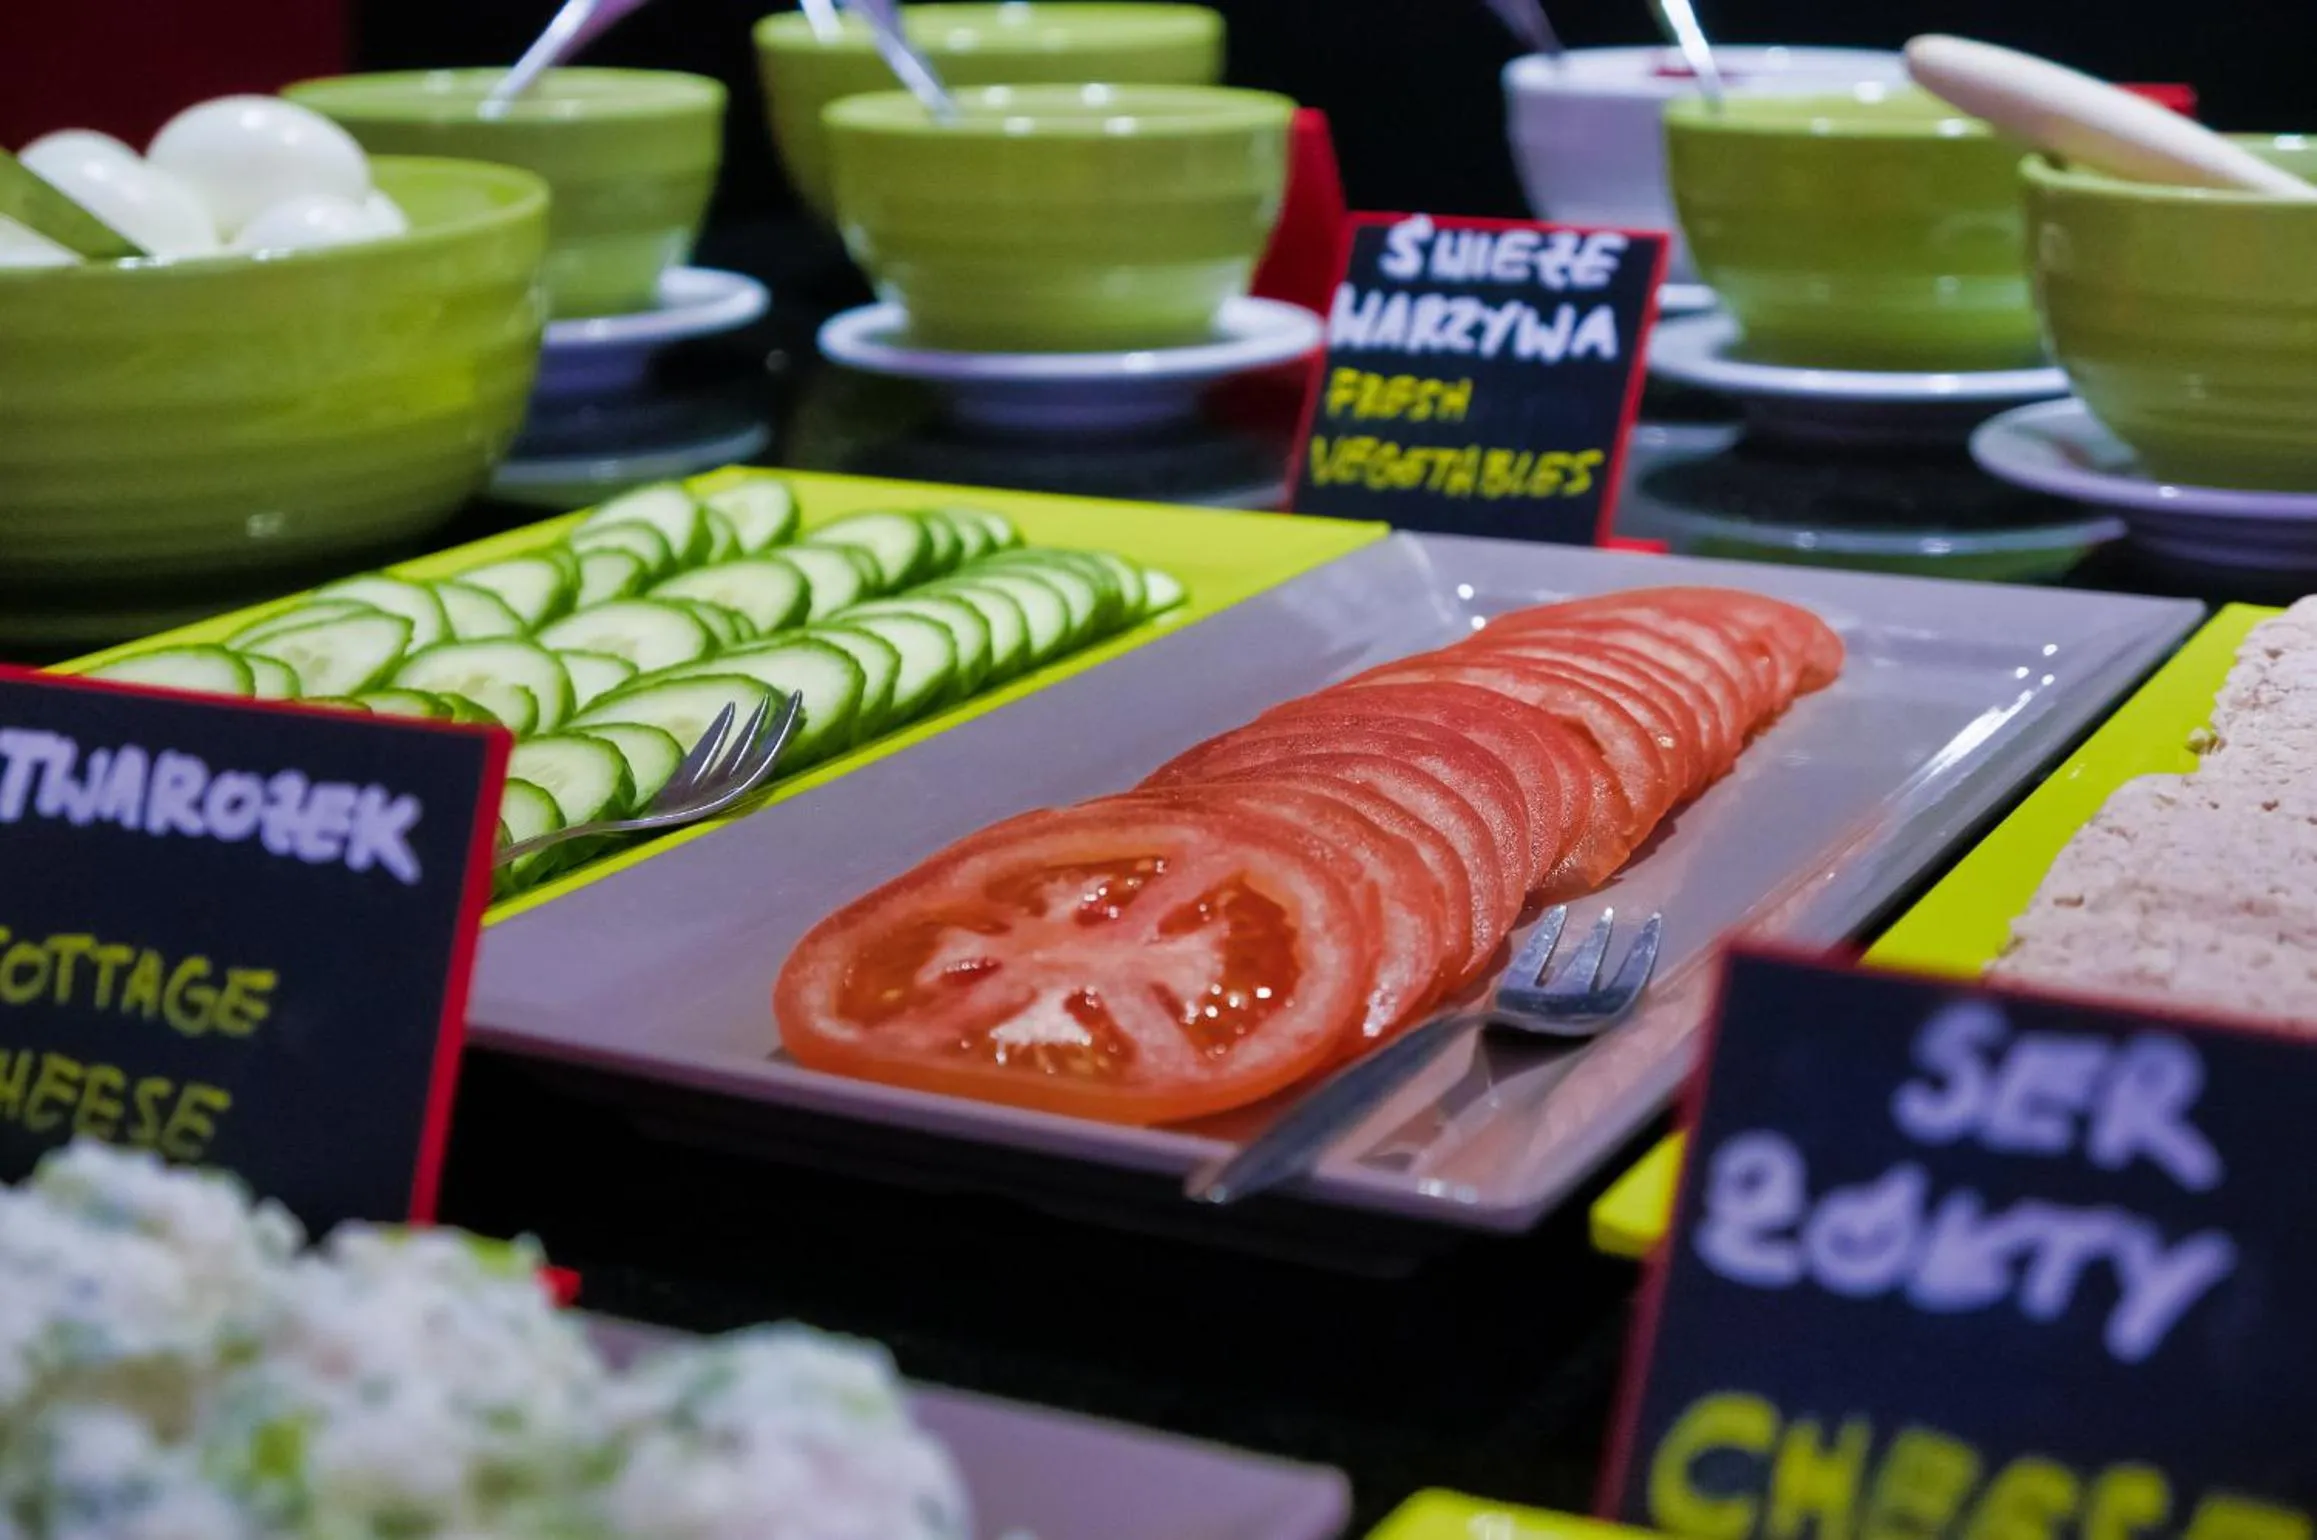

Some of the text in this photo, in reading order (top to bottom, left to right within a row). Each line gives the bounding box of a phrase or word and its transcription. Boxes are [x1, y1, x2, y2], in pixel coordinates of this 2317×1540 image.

[1329, 282, 1618, 362] WARZYWA
[1327, 367, 1473, 422] FRESH
[1310, 436, 1603, 498] VEGETABLES
[0, 926, 278, 1037] OTTAGE
[1892, 1000, 2222, 1190] SER
